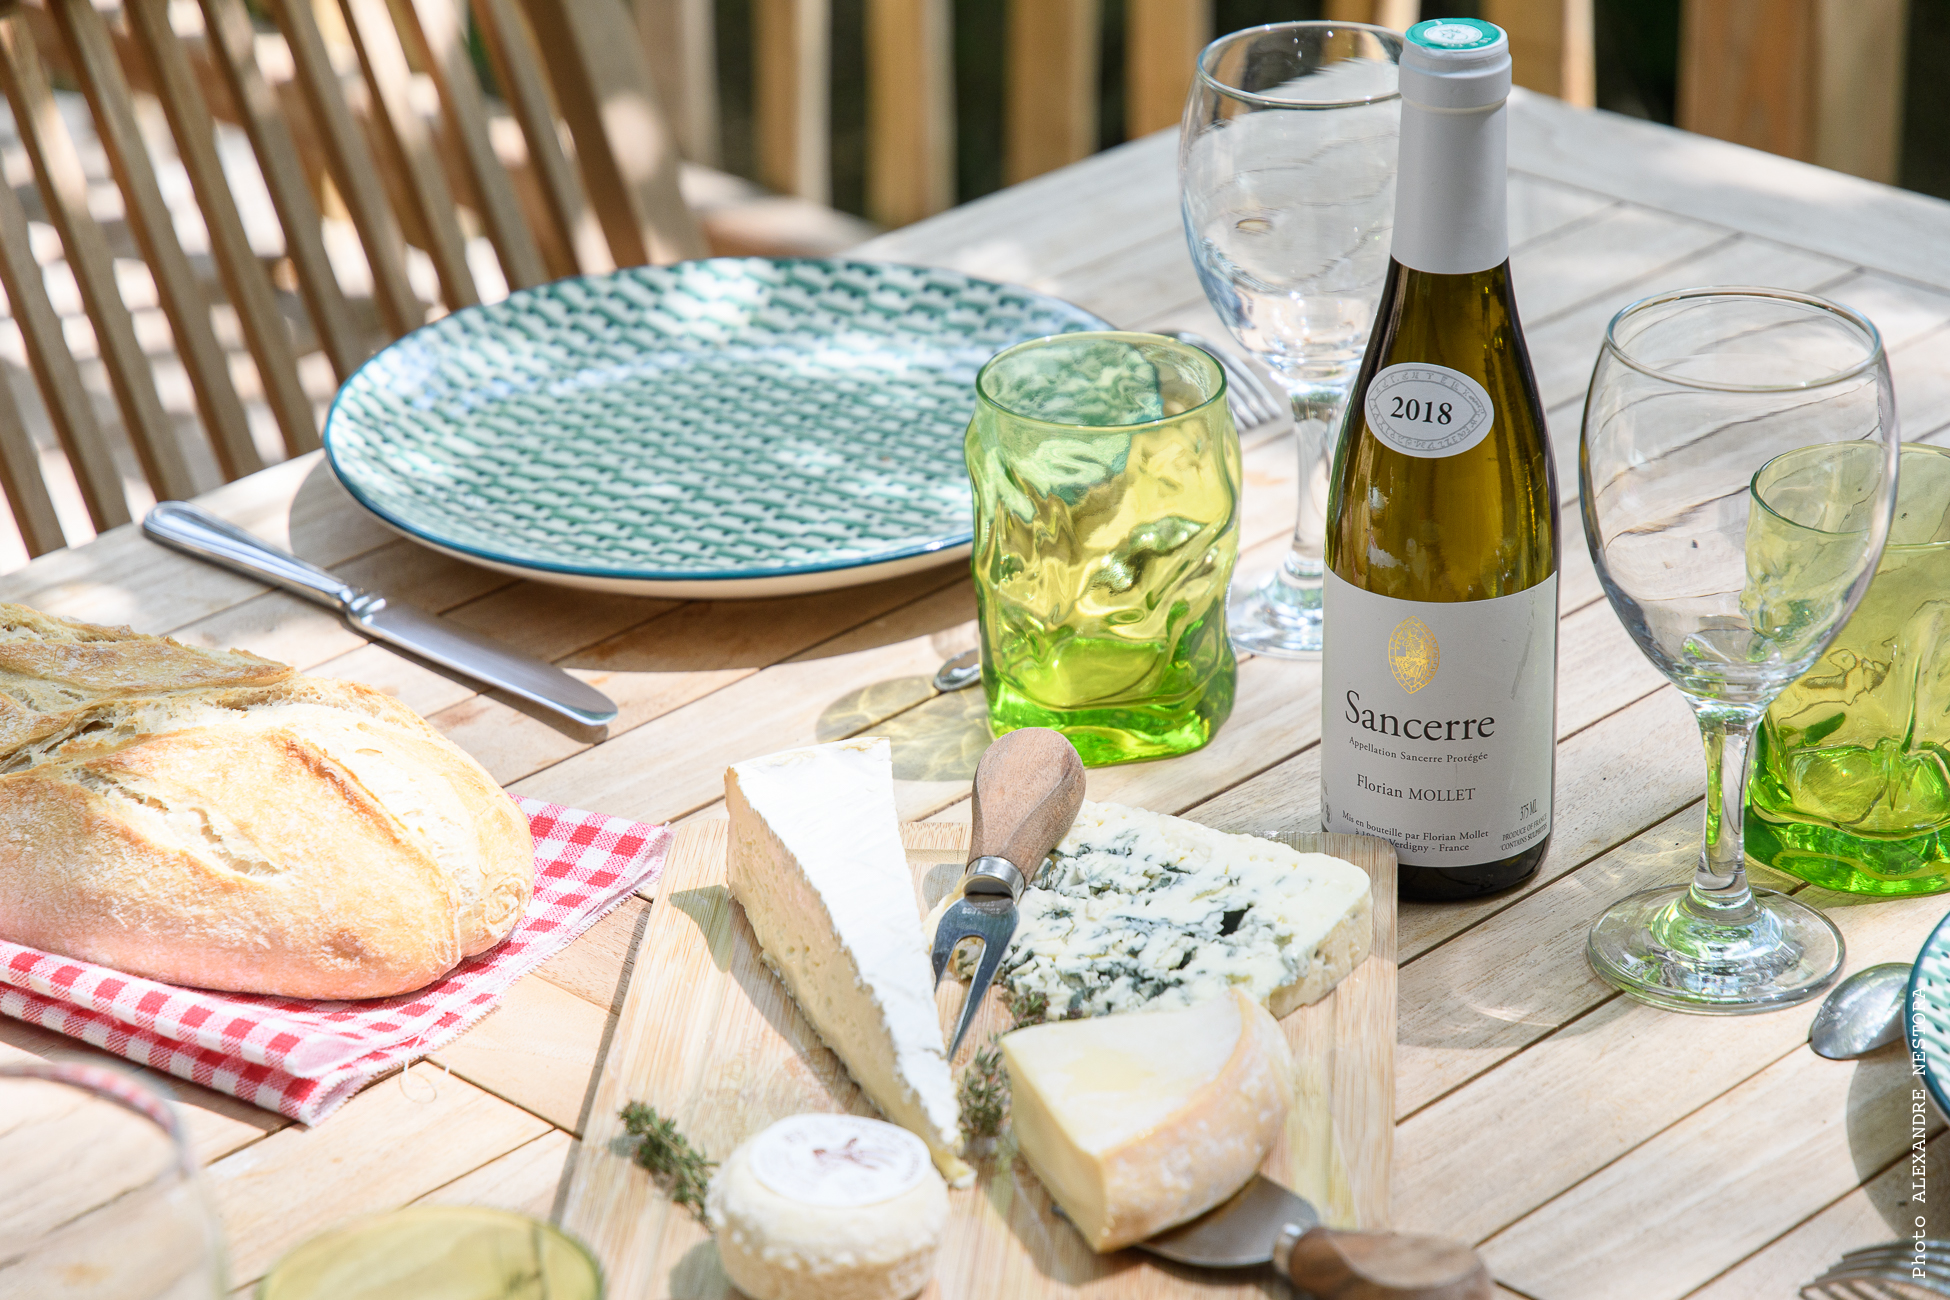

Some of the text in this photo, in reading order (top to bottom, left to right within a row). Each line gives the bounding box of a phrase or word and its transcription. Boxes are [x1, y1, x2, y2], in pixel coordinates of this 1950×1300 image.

[1390, 396, 1453, 425] 2018
[1345, 689, 1495, 741] Sancerre
[1349, 736, 1489, 764] Appellation Sancerre Protégée
[1357, 773, 1476, 802] Florian MOLLET
[1342, 809, 1354, 823] Mis
[1355, 819, 1364, 827] en
[1366, 821, 1403, 838] bouteille
[1405, 832, 1420, 841] par
[1422, 832, 1456, 841] Florian
[1459, 829, 1489, 841] Mollet
[1520, 803, 1529, 821] 375
[1388, 838, 1429, 853] Verdigny
[1439, 843, 1470, 852] France
[1501, 834, 1528, 851] CONTAINS
[1502, 826, 1526, 841] PRODUCE
